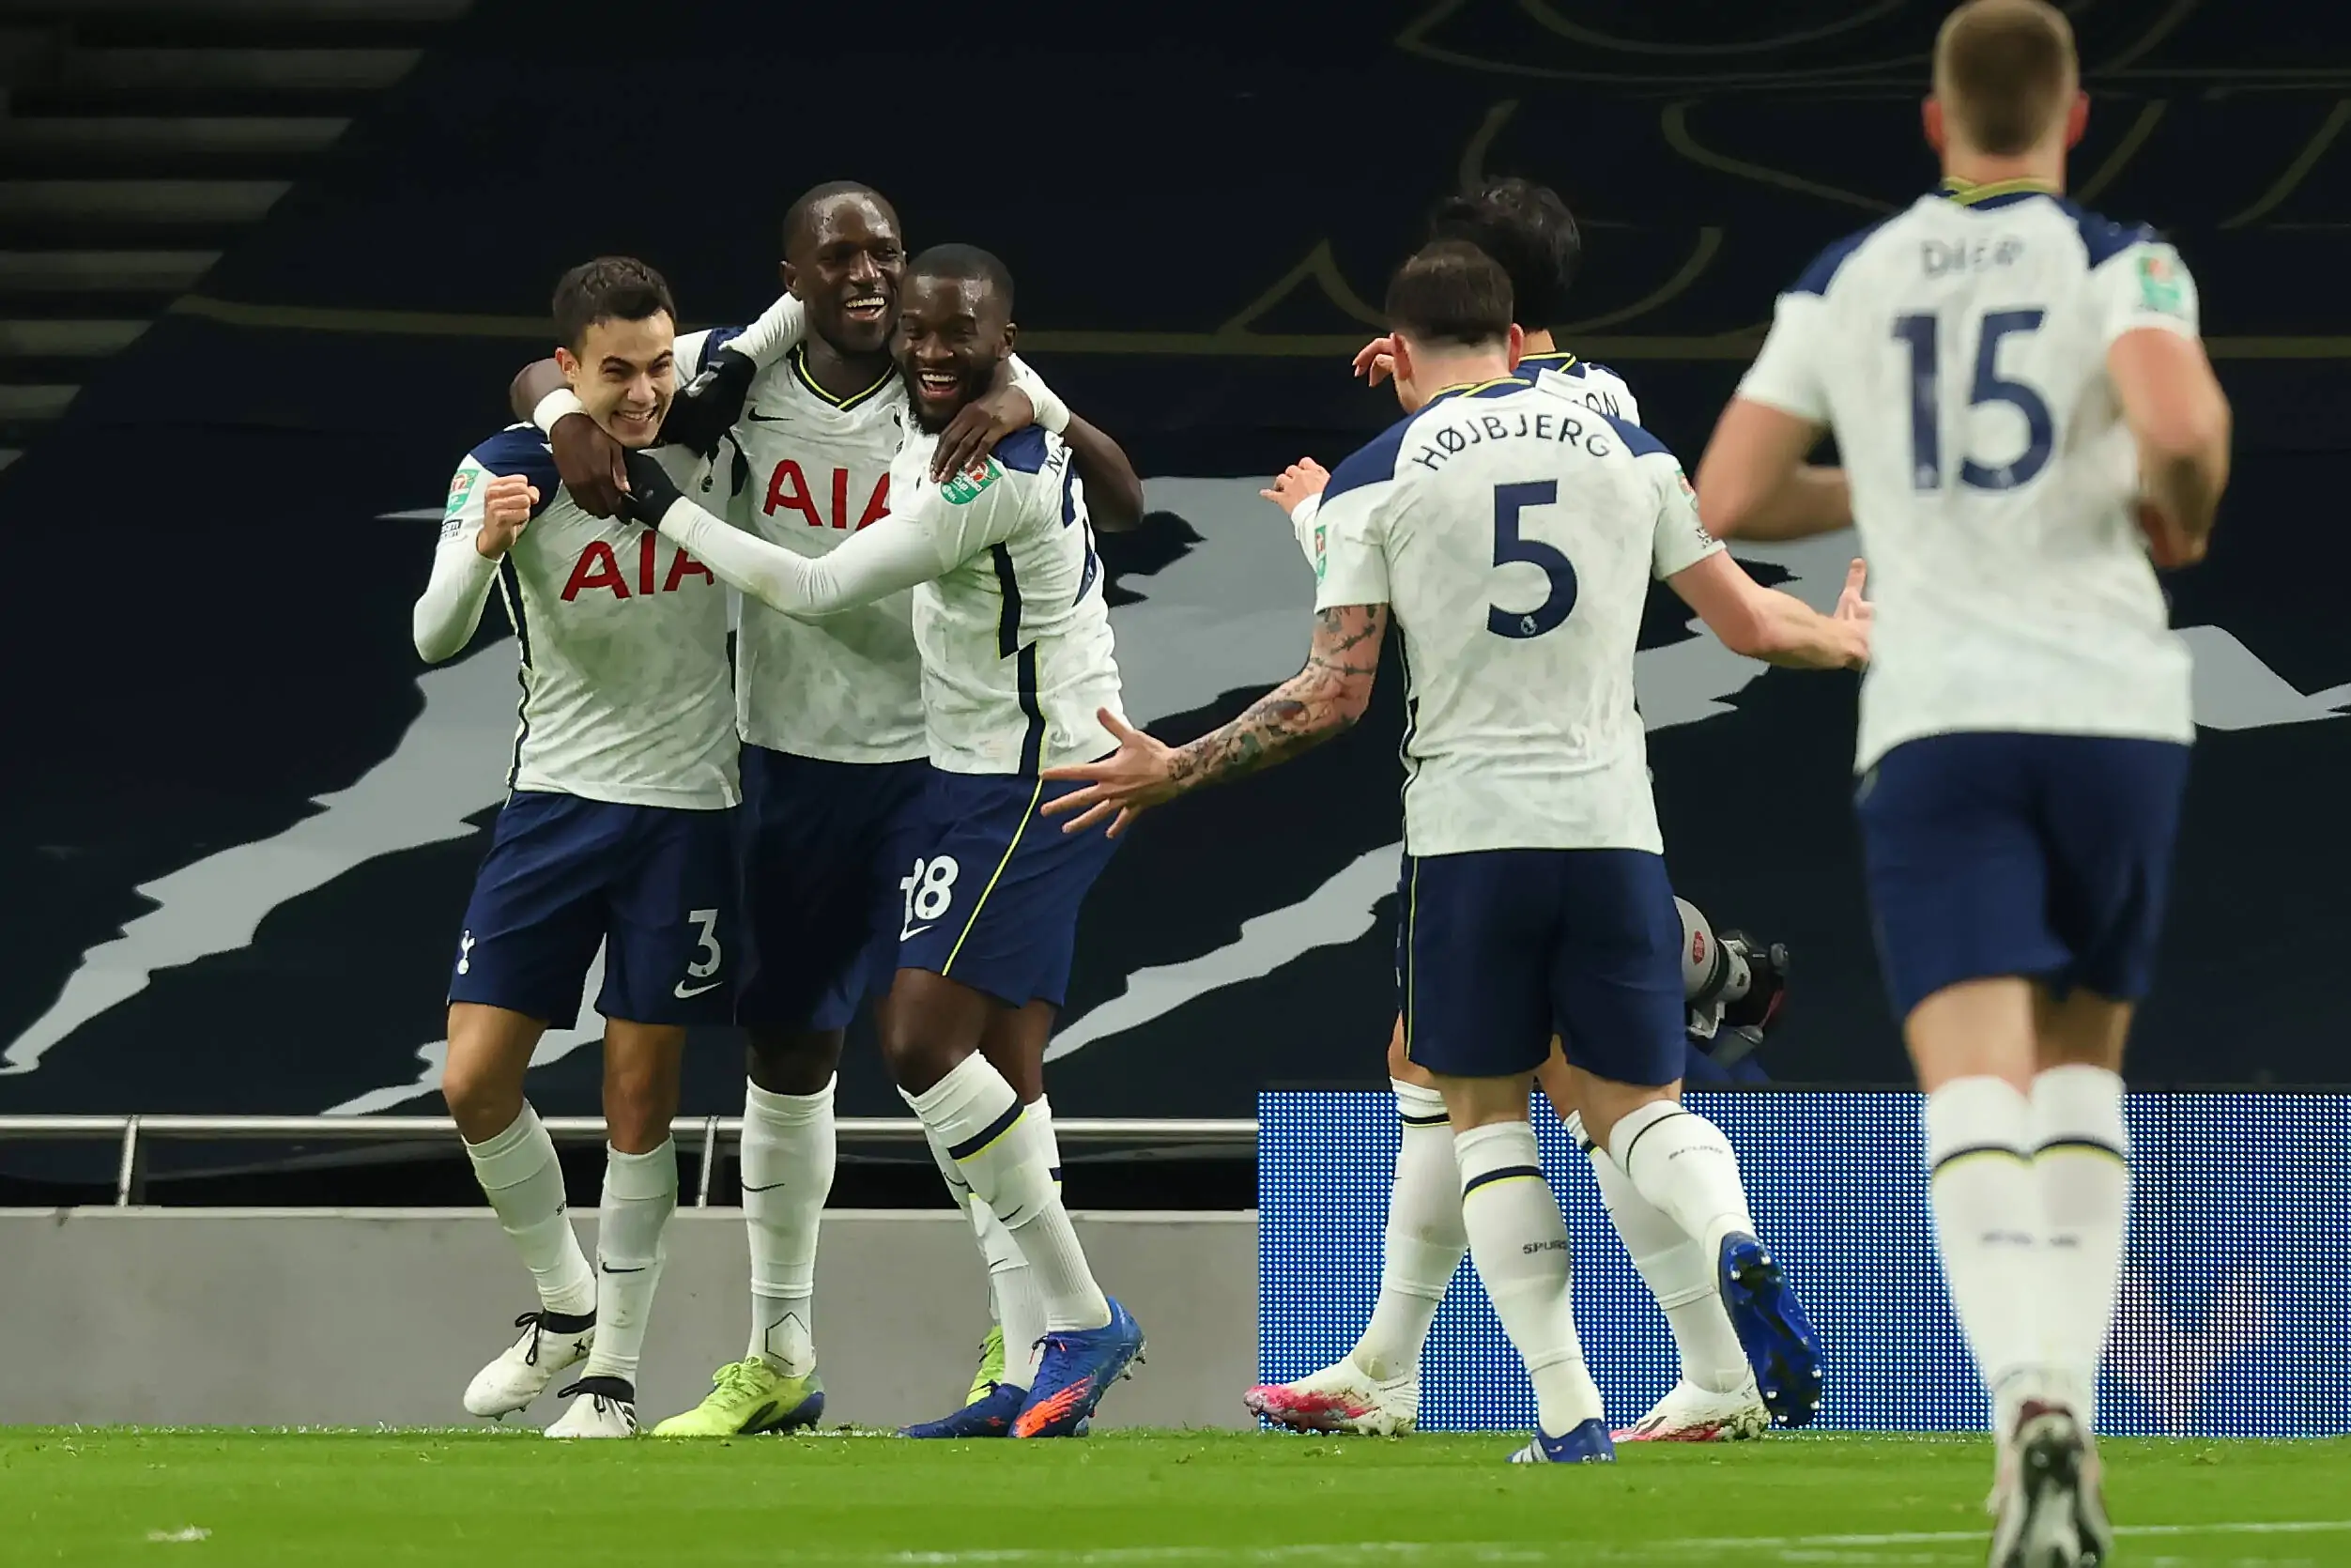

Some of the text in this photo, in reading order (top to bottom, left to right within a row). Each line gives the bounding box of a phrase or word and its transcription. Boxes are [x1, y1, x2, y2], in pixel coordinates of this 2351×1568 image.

[1572, 392, 1621, 419] ON
[1891, 309, 2052, 490] 15
[1412, 413, 1610, 471] HØJBJERG
[561, 528, 715, 602] AIA
[1486, 479, 1577, 639] 5
[687, 908, 722, 977] 3
